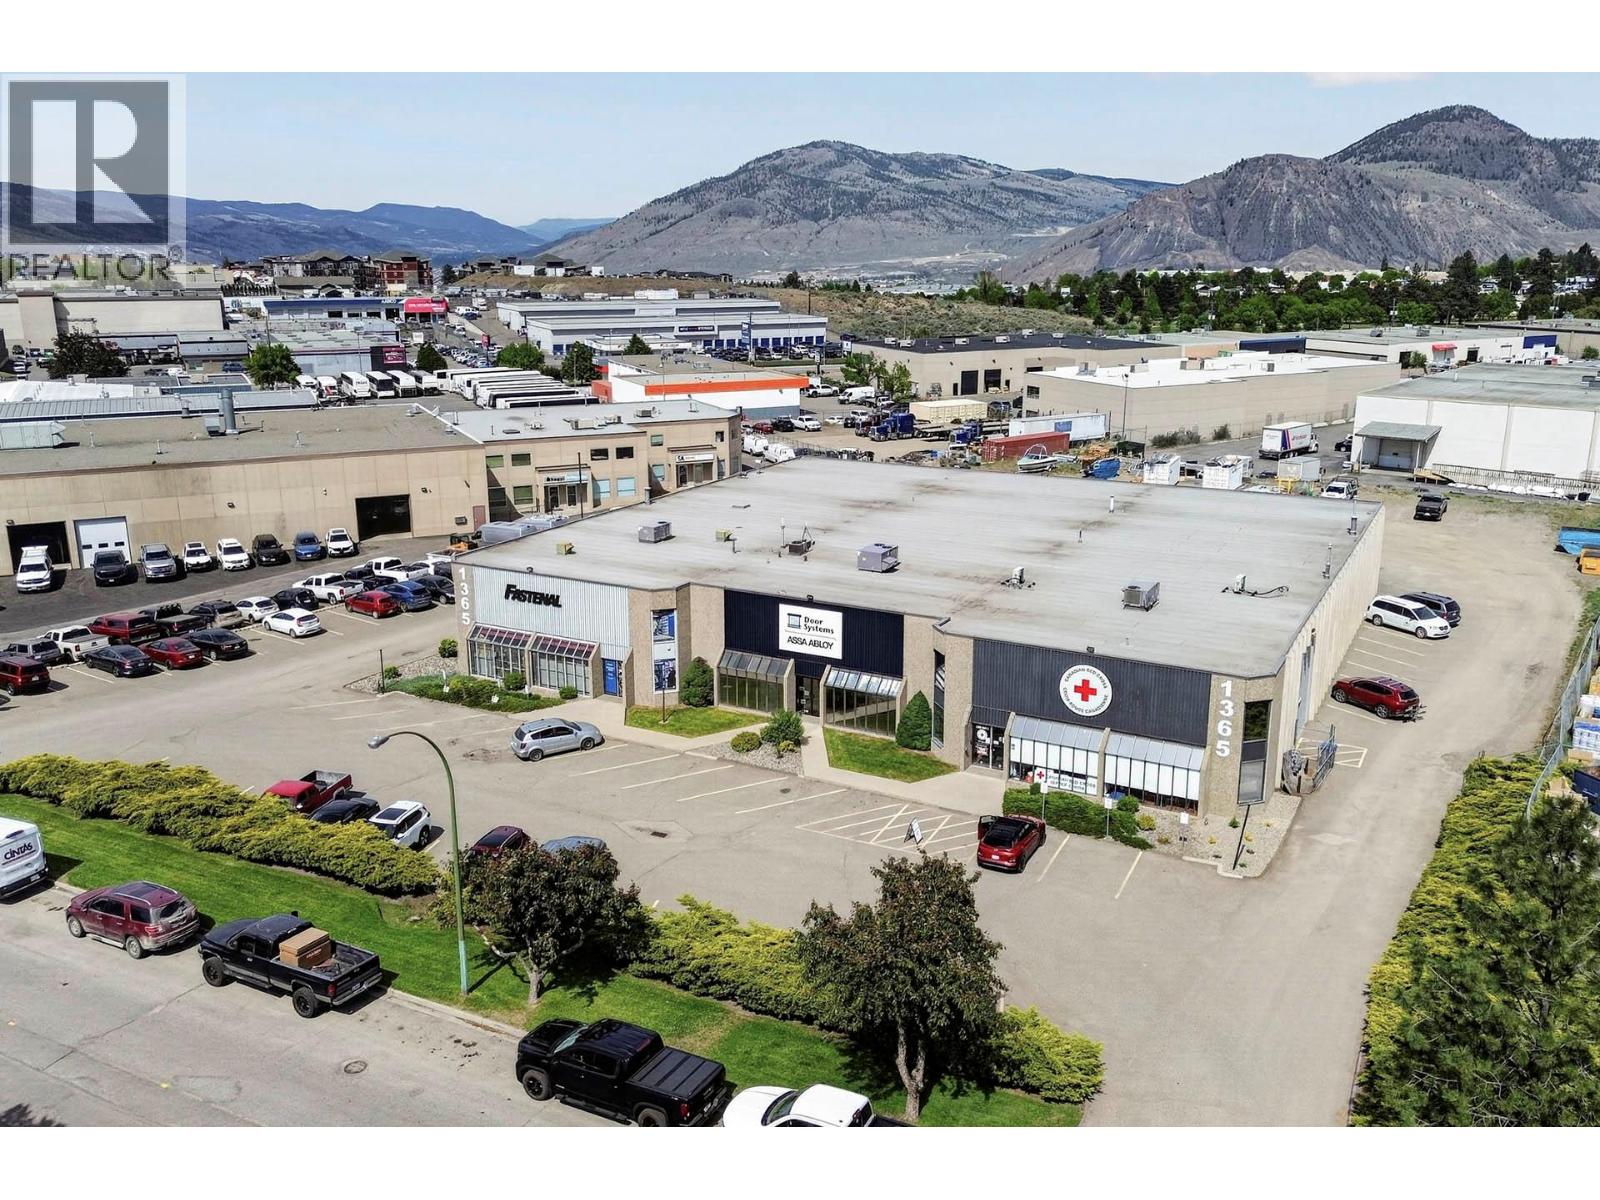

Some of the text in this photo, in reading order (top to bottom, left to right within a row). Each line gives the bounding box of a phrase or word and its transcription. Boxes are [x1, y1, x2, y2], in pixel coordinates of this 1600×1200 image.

[458, 566, 471, 625] 1365
[504, 583, 562, 609] FASTENAL
[804, 616, 823, 624] Door
[804, 624, 834, 634] Systems
[787, 636, 834, 650] ASSA ABLOY
[1215, 679, 1235, 758] 1365
[4, 843, 33, 859] CINTAS
